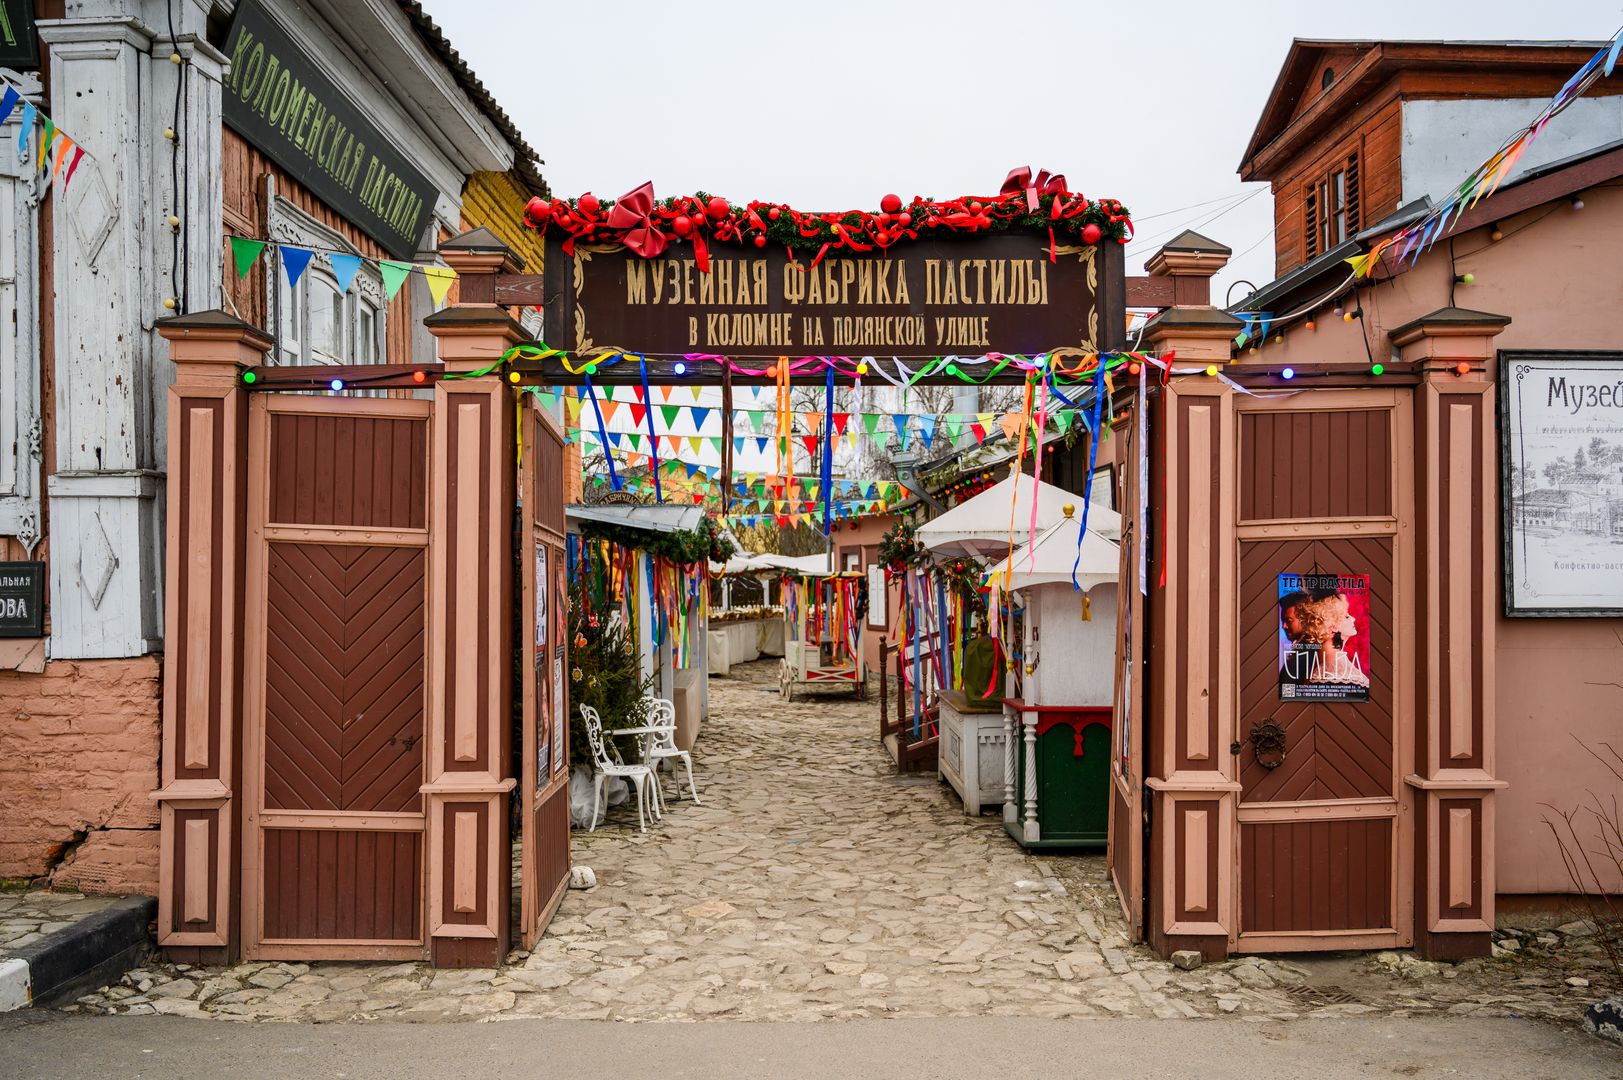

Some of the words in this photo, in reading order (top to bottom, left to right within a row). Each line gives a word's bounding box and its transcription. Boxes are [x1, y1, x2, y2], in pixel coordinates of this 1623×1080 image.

[225, 25, 366, 195] КОЛОМЕНСКАЯ
[626, 254, 768, 305] МУЗЕЙНАЯ
[783, 258, 911, 305] ФАБРИКА
[925, 258, 1049, 305] ПАСТИЛЫ
[706, 313, 793, 346] КОЛОМНЕ
[803, 317, 824, 346] НА
[833, 313, 926, 346] ПОЛЯНСКОЙ
[935, 316, 990, 347] УЛИЦЕ
[1282, 577, 1318, 589] ТЕАТР
[1319, 577, 1366, 589] PASTILA
